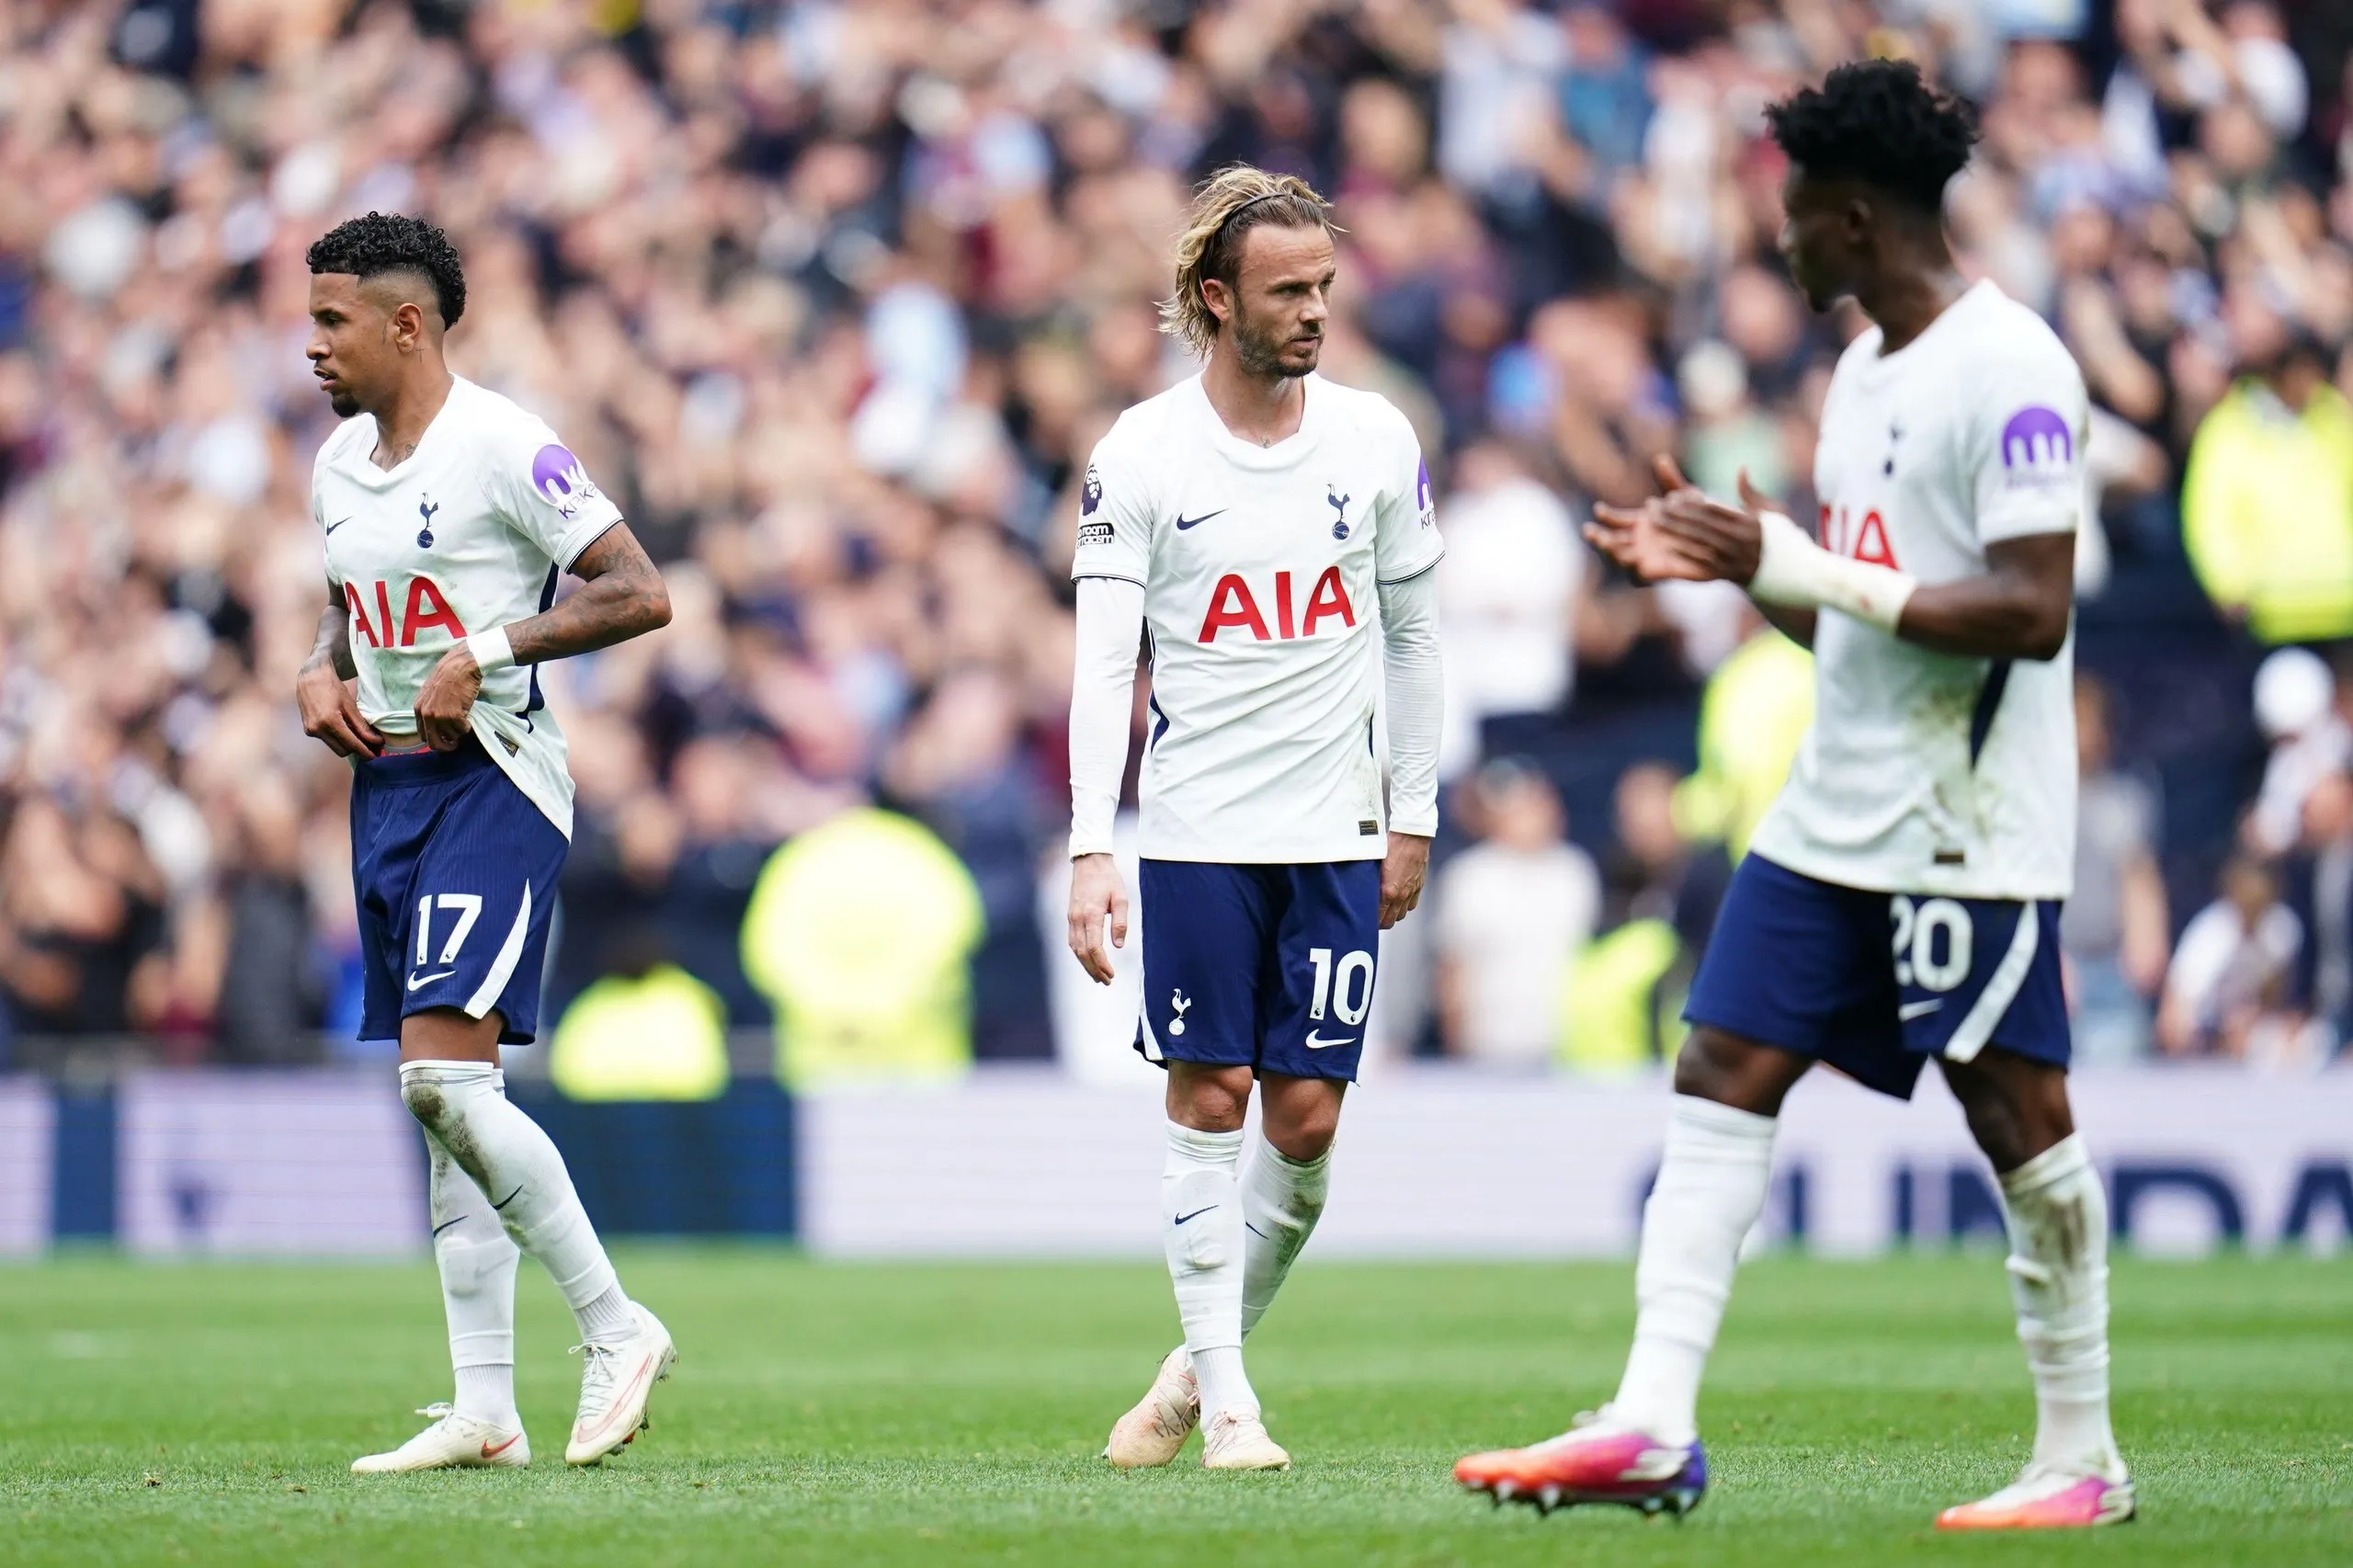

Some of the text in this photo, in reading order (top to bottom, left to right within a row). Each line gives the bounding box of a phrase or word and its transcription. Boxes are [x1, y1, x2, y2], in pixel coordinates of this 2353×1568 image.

[345, 576, 468, 648] AIA
[1198, 565, 1357, 643] AIA
[416, 893, 483, 966] 17
[1309, 948, 1375, 1026] 10
